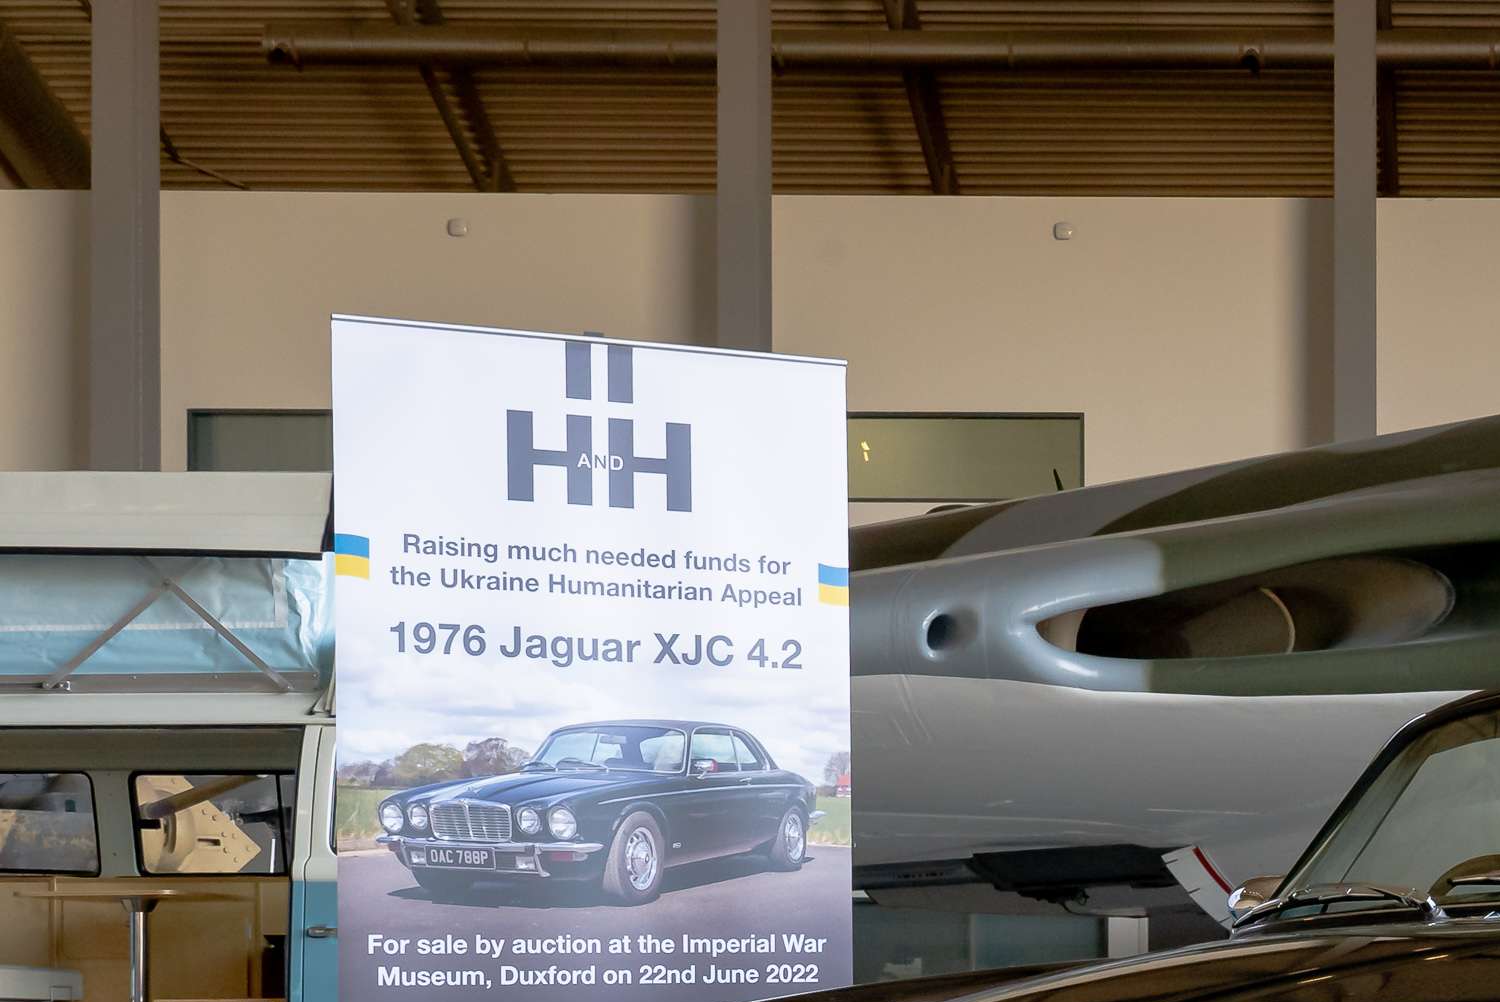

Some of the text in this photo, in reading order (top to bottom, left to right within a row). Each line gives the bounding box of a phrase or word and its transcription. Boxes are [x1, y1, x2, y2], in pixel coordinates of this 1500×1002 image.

[577, 452, 624, 471] AND
[404, 534, 791, 574] Raising much needed funds for
[390, 566, 801, 608] the Ukraine Humanitarian Appeal
[390, 622, 801, 669] 1976 Jaguar XJC 4.2
[430, 850, 488, 865] OAC 788P
[369, 934, 826, 958] For sale by auction at the Imperial War
[378, 964, 819, 988] Museum, Duxford on 22nd June 2022
